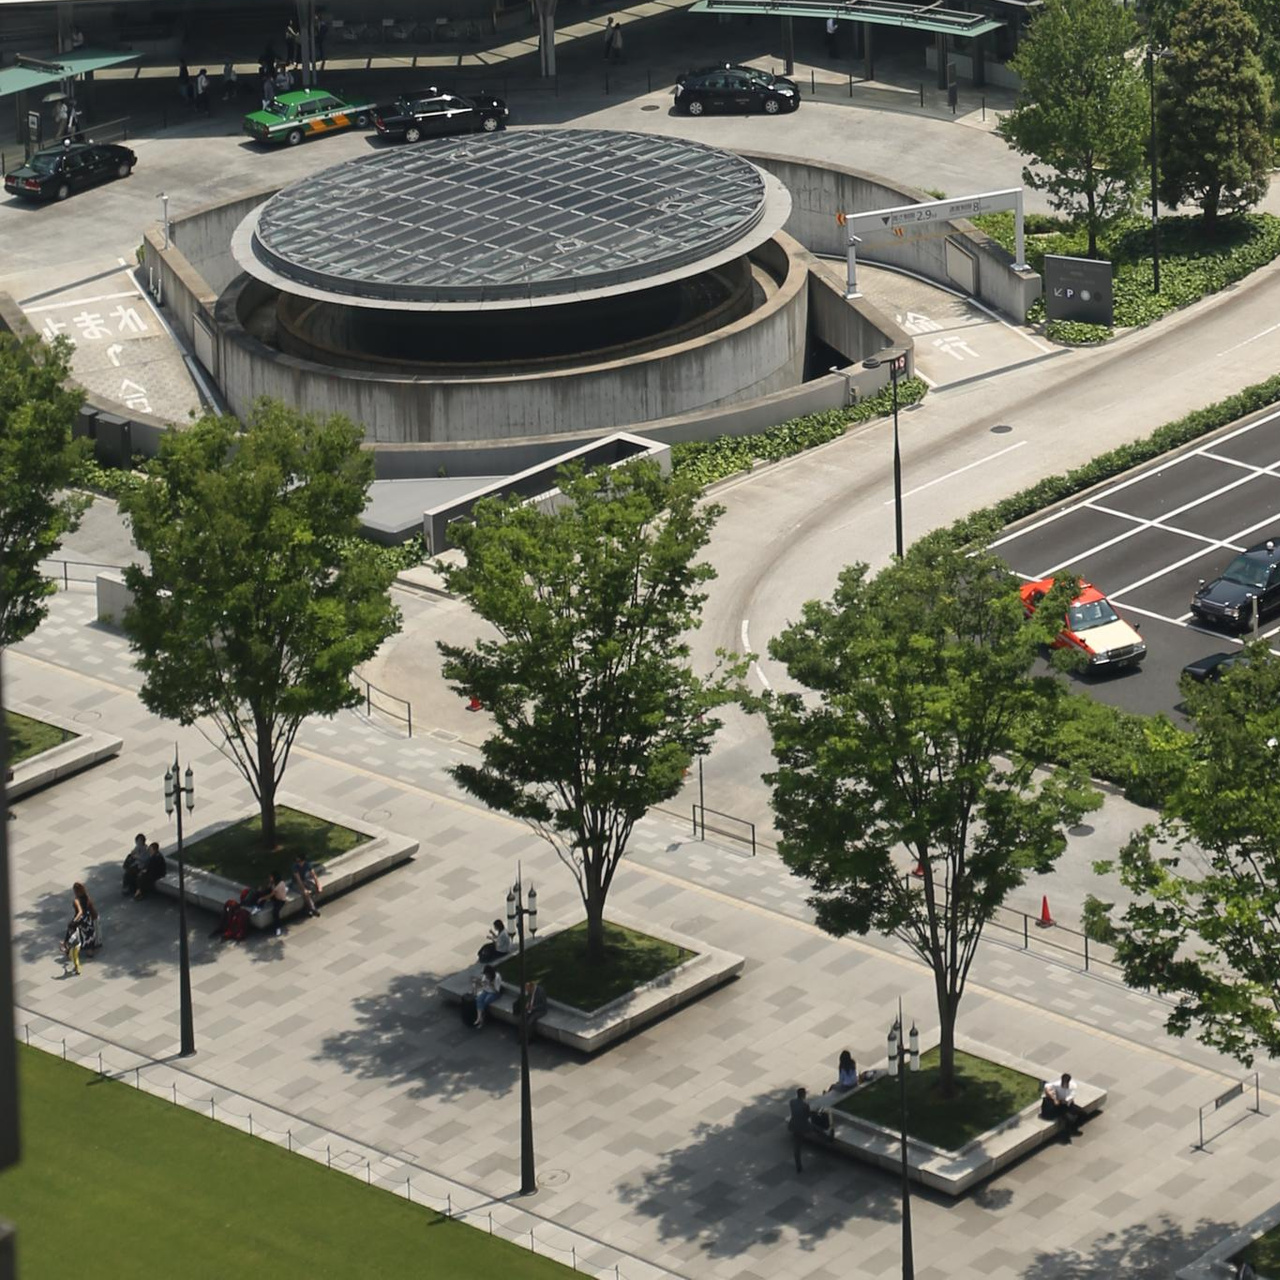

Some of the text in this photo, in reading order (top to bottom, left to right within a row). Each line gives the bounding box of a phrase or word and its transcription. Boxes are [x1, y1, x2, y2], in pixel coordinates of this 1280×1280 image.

[973, 202, 980, 212] 8
[916, 210, 932, 221] 2.9
[1066, 288, 1074, 298] P
